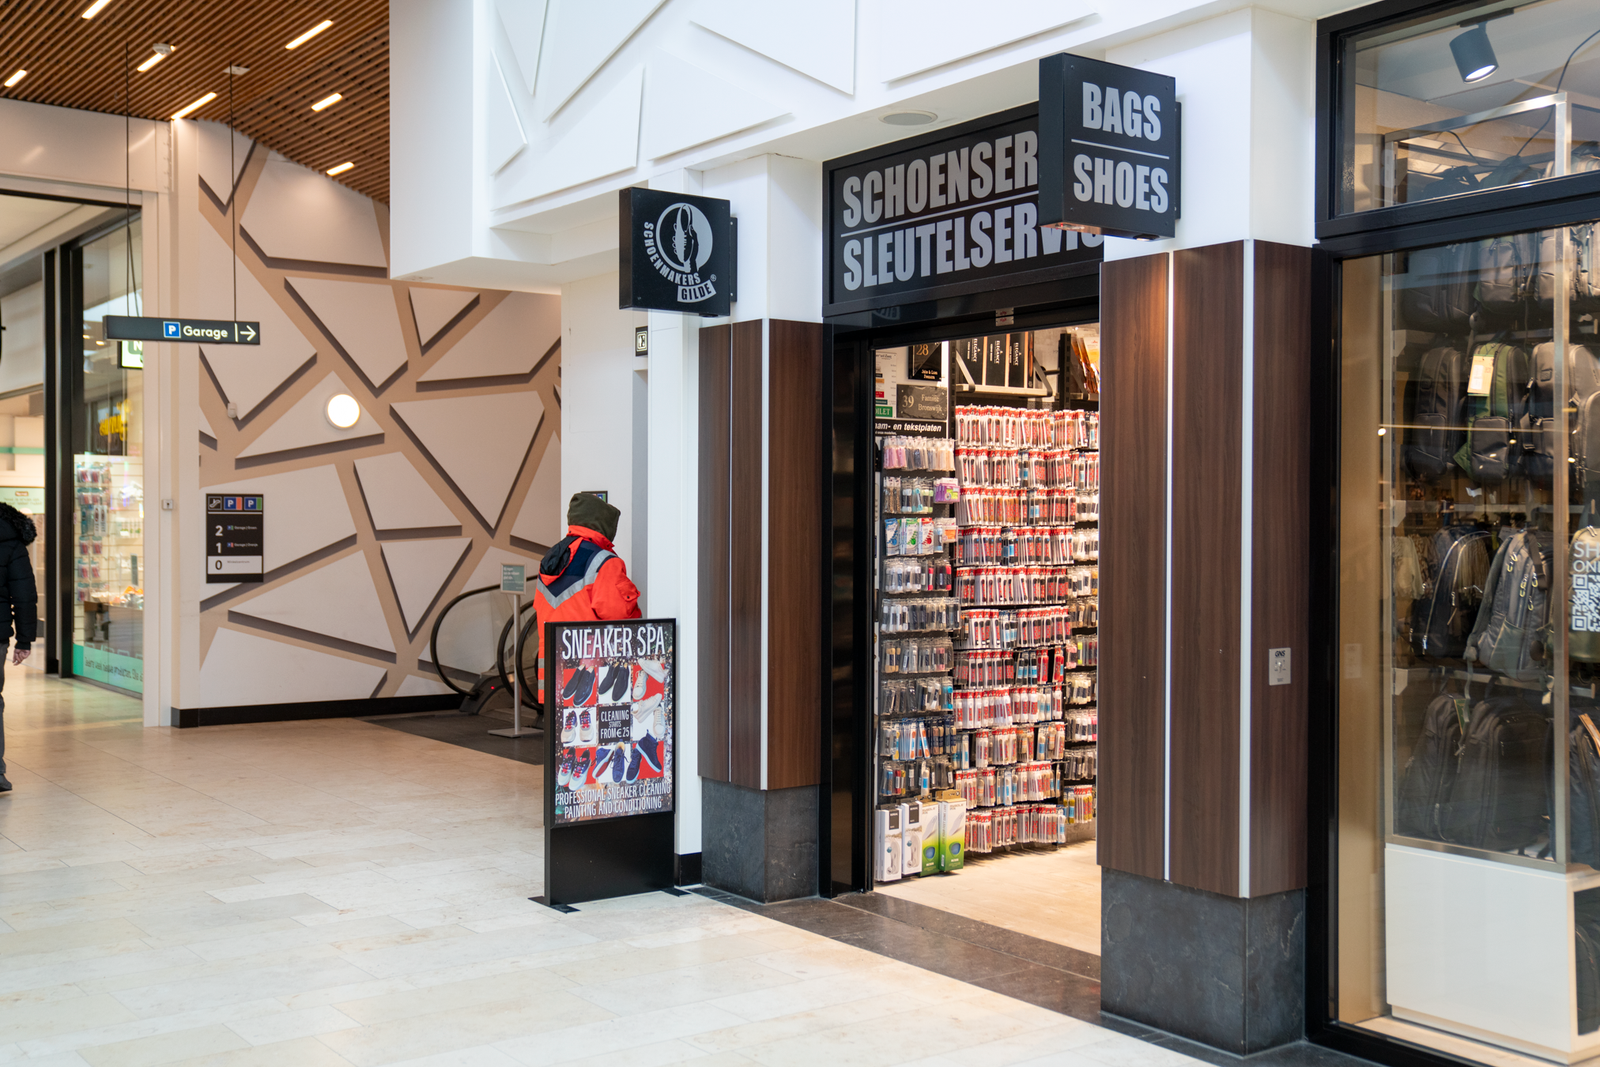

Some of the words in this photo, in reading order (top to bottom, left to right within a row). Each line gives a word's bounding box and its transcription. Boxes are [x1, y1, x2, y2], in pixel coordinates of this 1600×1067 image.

[1082, 81, 1162, 142] BAGS
[1073, 154, 1169, 214] SHOES
[643, 221, 701, 286] SCHOENMAKERS
[681, 283, 712, 301] GILDE
[183, 325, 228, 341] Garage
[902, 395, 914, 408] 39
[904, 423, 942, 433] tekstplaten
[215, 525, 223, 536] 2
[216, 542, 222, 553] 1
[215, 559, 223, 570] 0
[561, 627, 633, 660] SNEAKER
[637, 626, 665, 657] SPA
[600, 709, 630, 722] CLEANING
[600, 728, 617, 739] FROM
[555, 789, 605, 806] PROFESSIONAL
[608, 784, 637, 800] SNEAKER
[639, 781, 671, 797] CLEANING
[564, 803, 597, 819] PAINTING
[598, 801, 613, 815] AND
[614, 796, 662, 813] CONDITIONING
